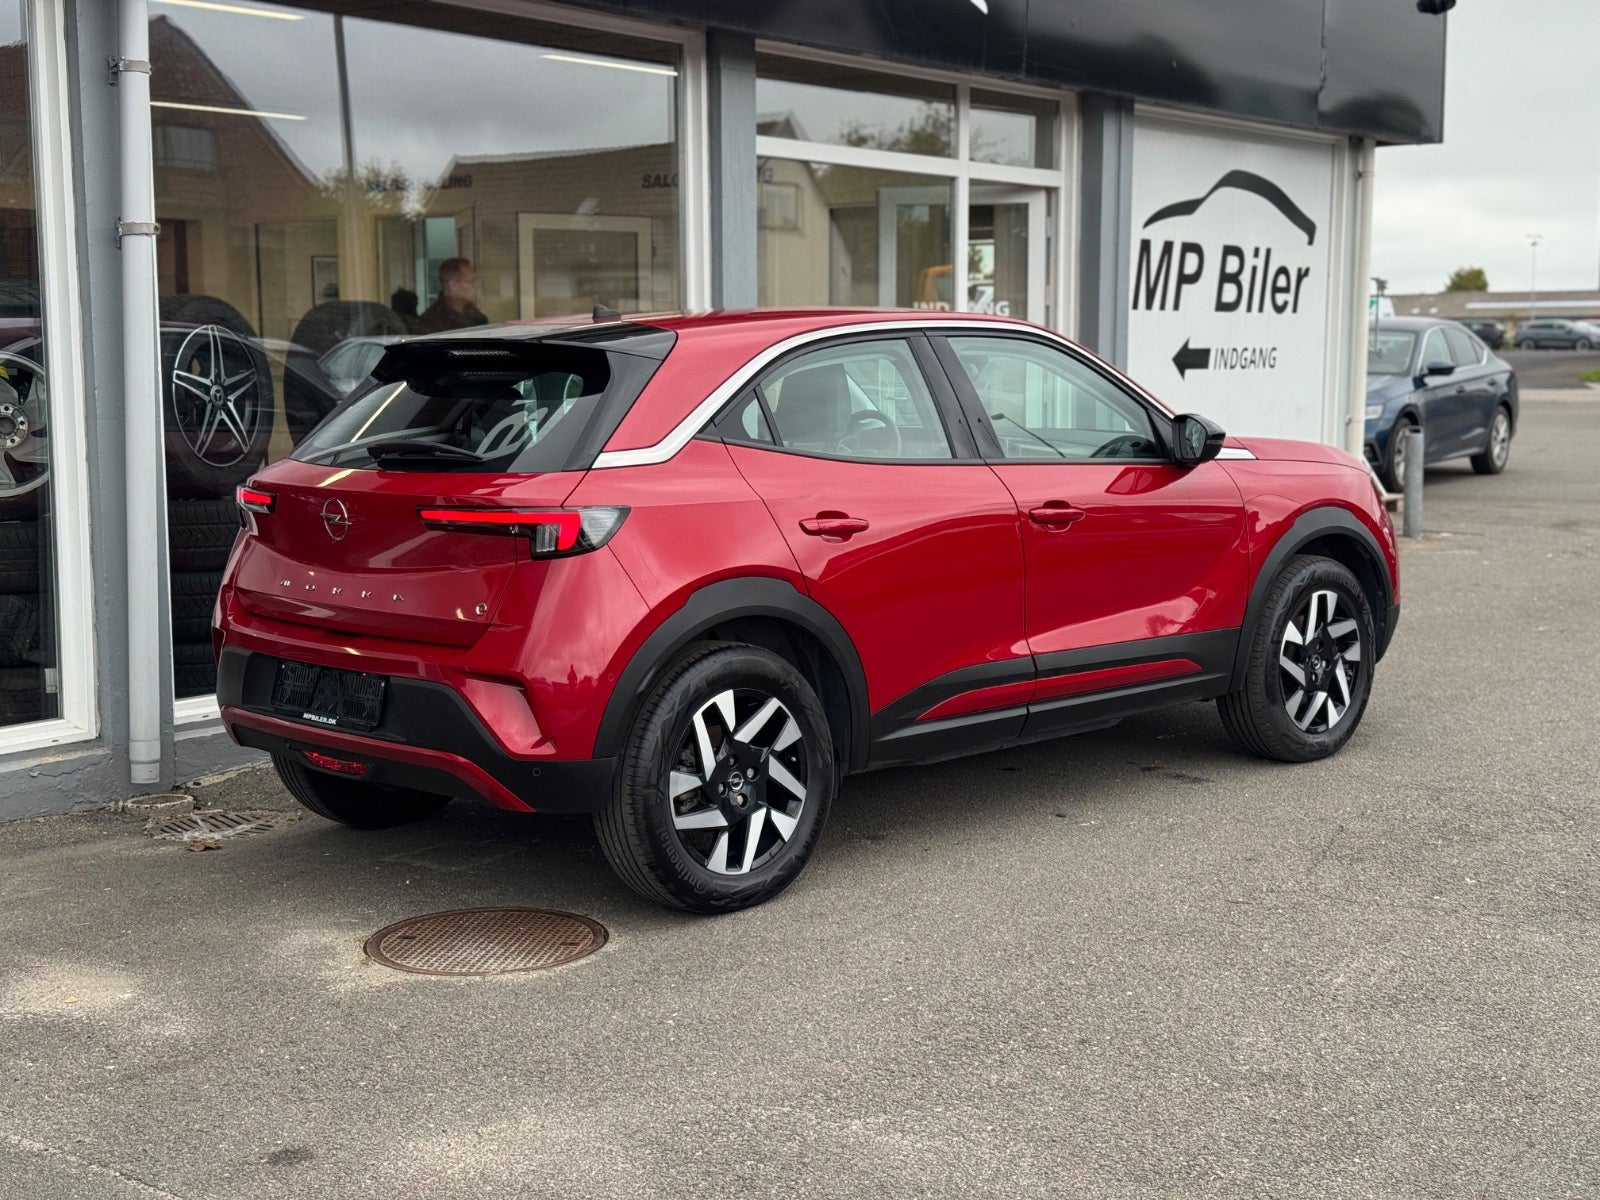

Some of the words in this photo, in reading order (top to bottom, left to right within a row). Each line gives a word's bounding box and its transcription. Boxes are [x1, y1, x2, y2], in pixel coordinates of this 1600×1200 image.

[1132, 238, 1205, 311] MP
[1215, 244, 1310, 314] Biler
[1213, 347, 1277, 369] INDGANG
[280, 579, 405, 601] MOKKA
